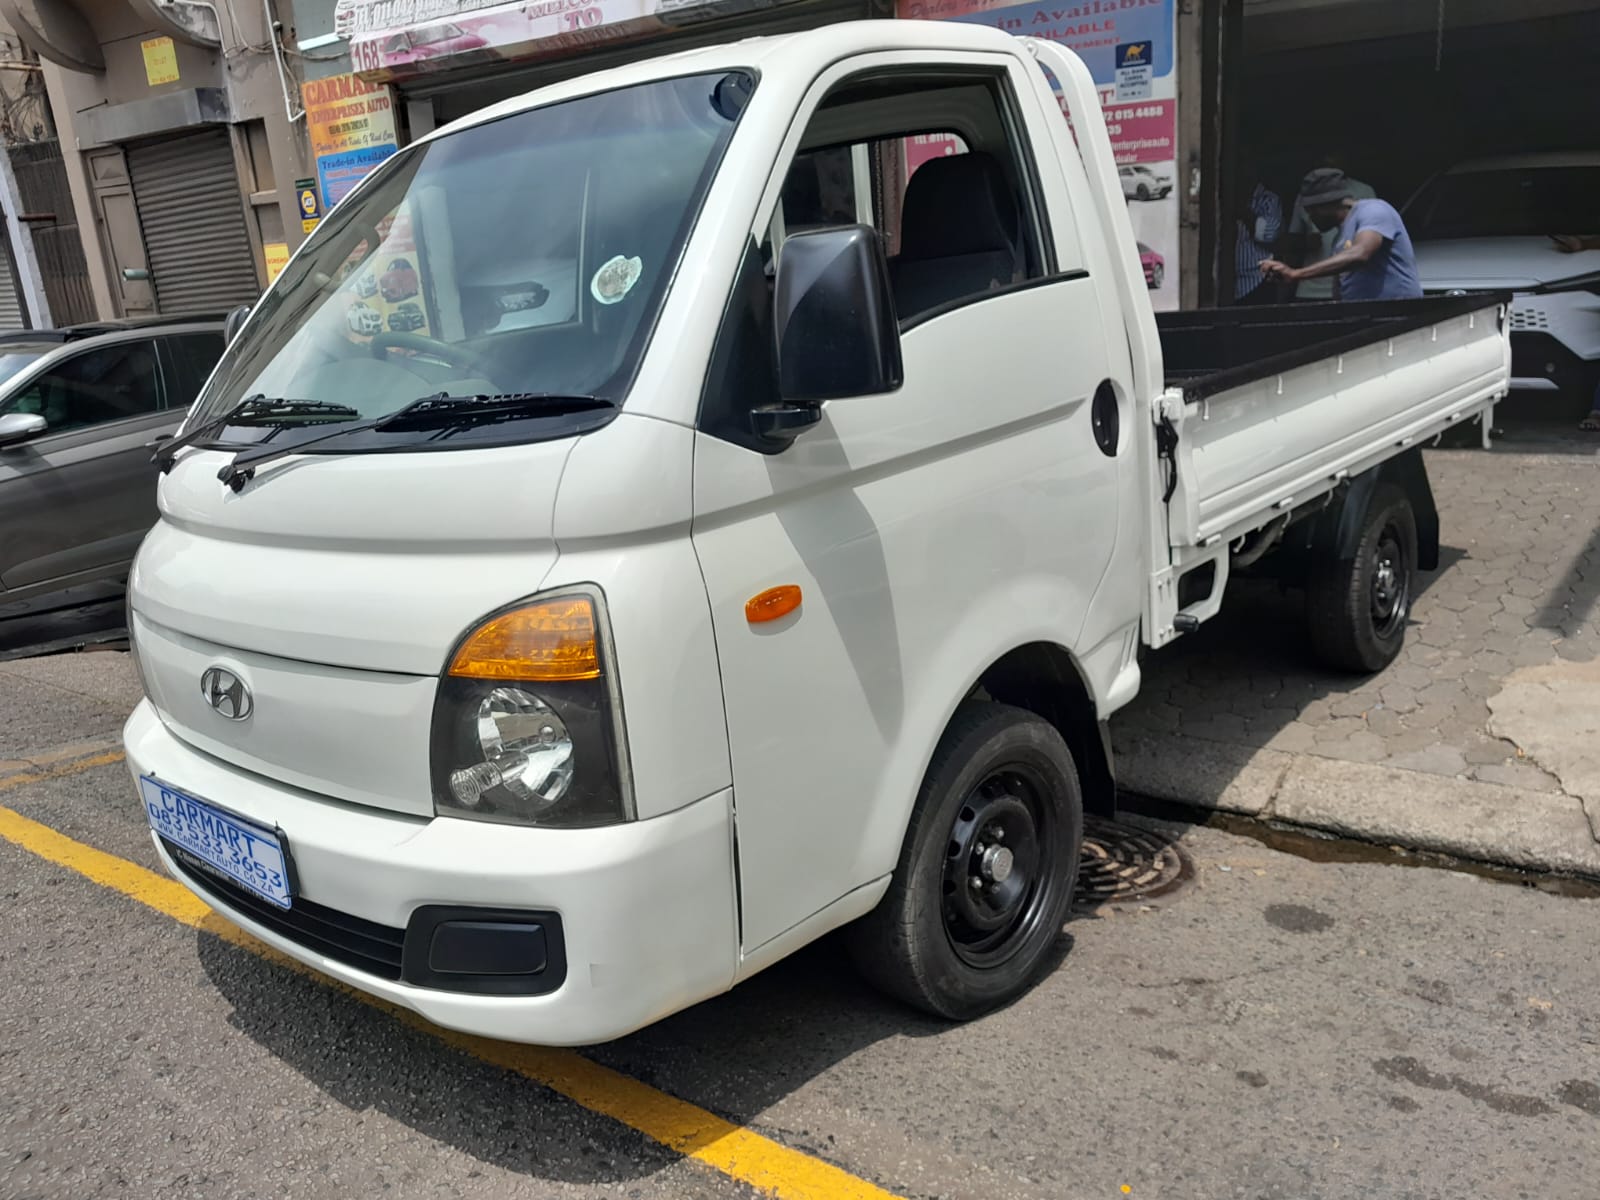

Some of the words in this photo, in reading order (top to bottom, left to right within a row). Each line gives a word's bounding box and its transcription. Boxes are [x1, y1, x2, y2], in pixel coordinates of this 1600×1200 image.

[565, 7, 603, 31] TO
[1030, 20, 1115, 39] AILABLE
[305, 75, 385, 106] CARMA
[367, 96, 390, 114] AUTO
[161, 790, 255, 858] CARMART
[149, 802, 183, 831] 083
[188, 824, 223, 855] 533
[229, 846, 282, 888] 3653
